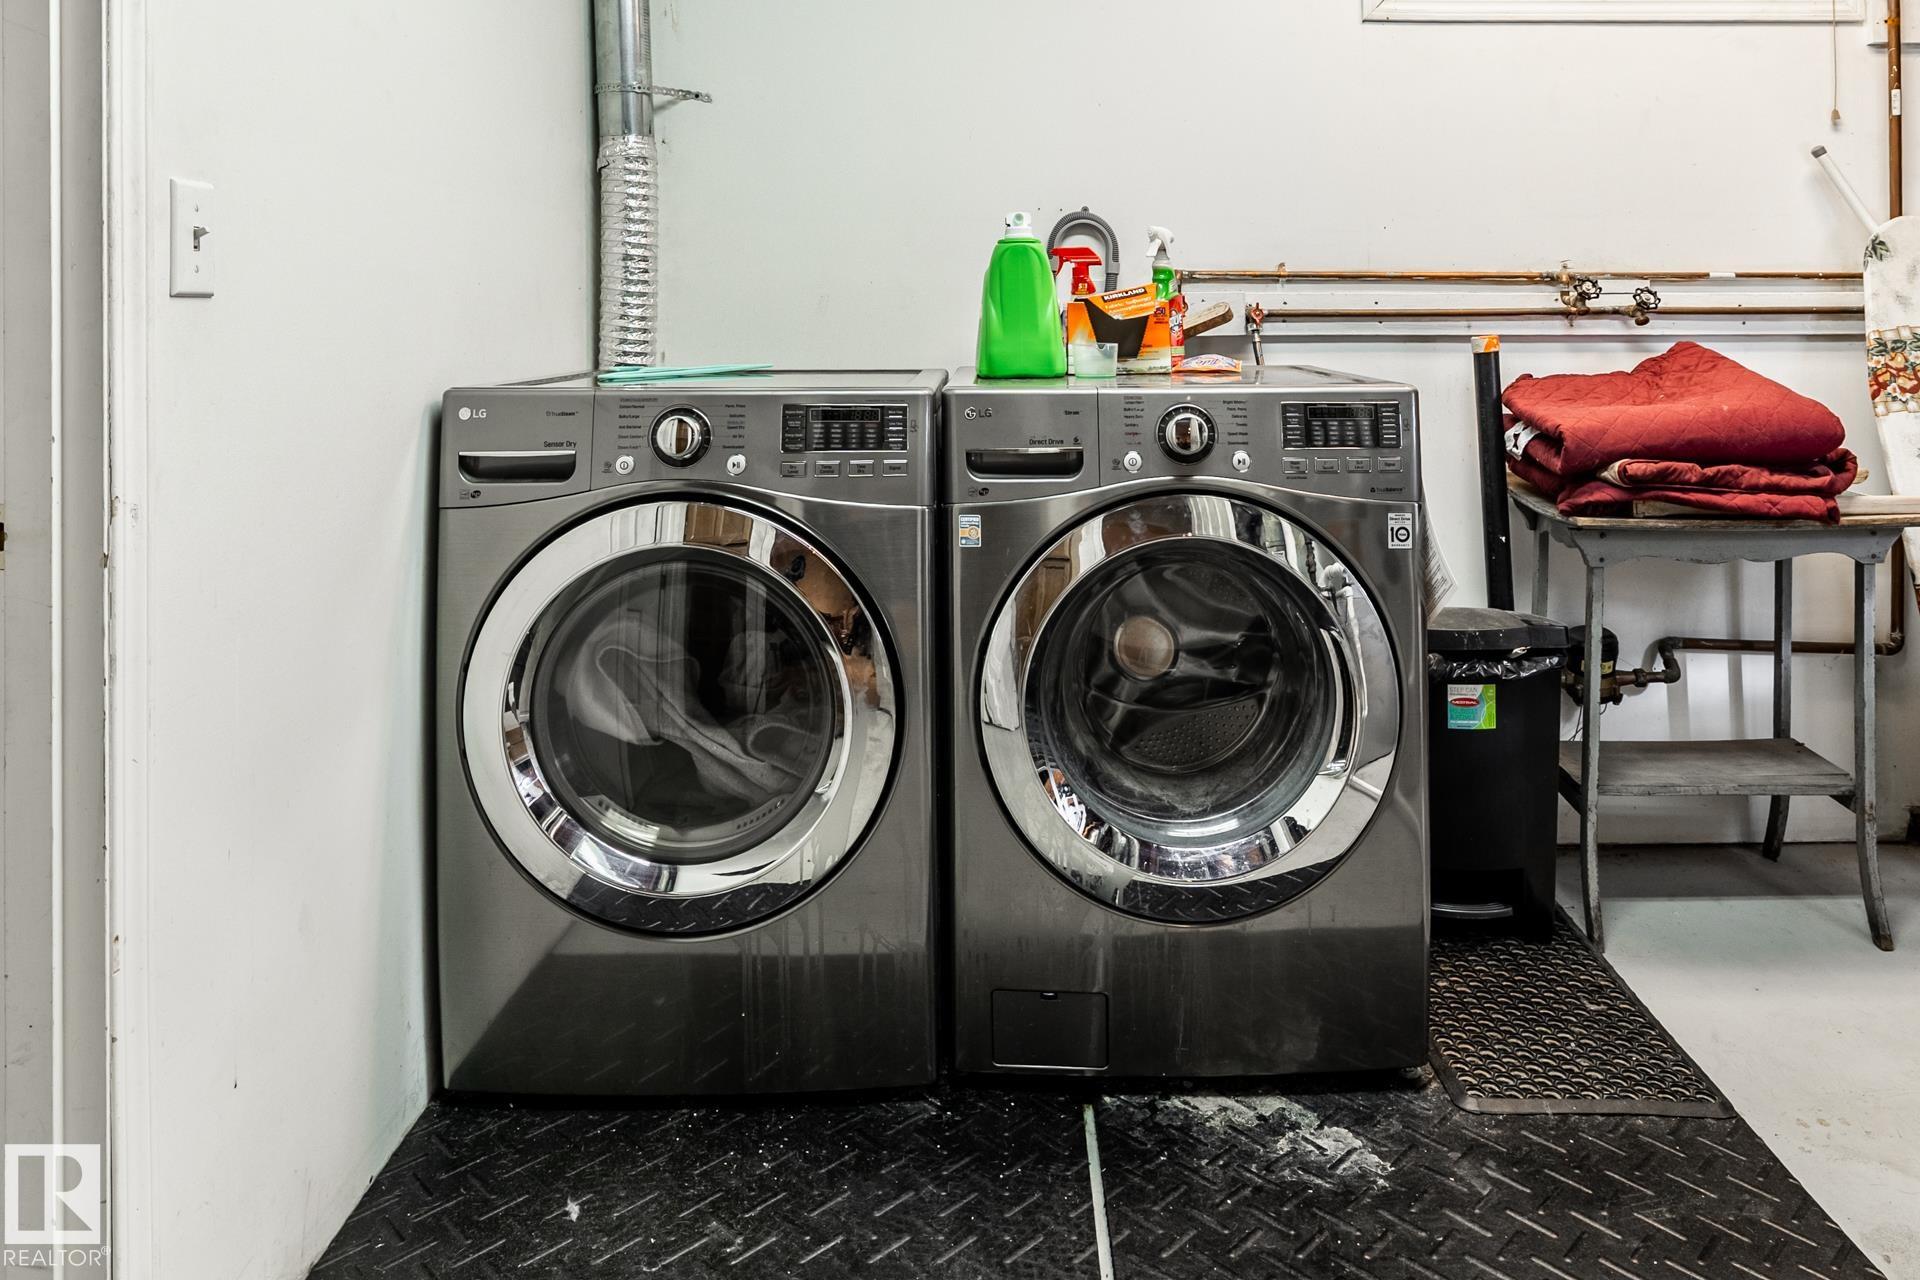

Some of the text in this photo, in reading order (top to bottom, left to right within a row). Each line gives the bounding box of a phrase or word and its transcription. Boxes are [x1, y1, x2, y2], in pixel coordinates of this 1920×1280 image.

[1103, 288, 1145, 301] KIRKLAND
[472, 408, 487, 418] LG
[978, 408, 993, 418] LG
[1028, 438, 1065, 446] Direct Drive
[1390, 526, 1410, 543] 10
